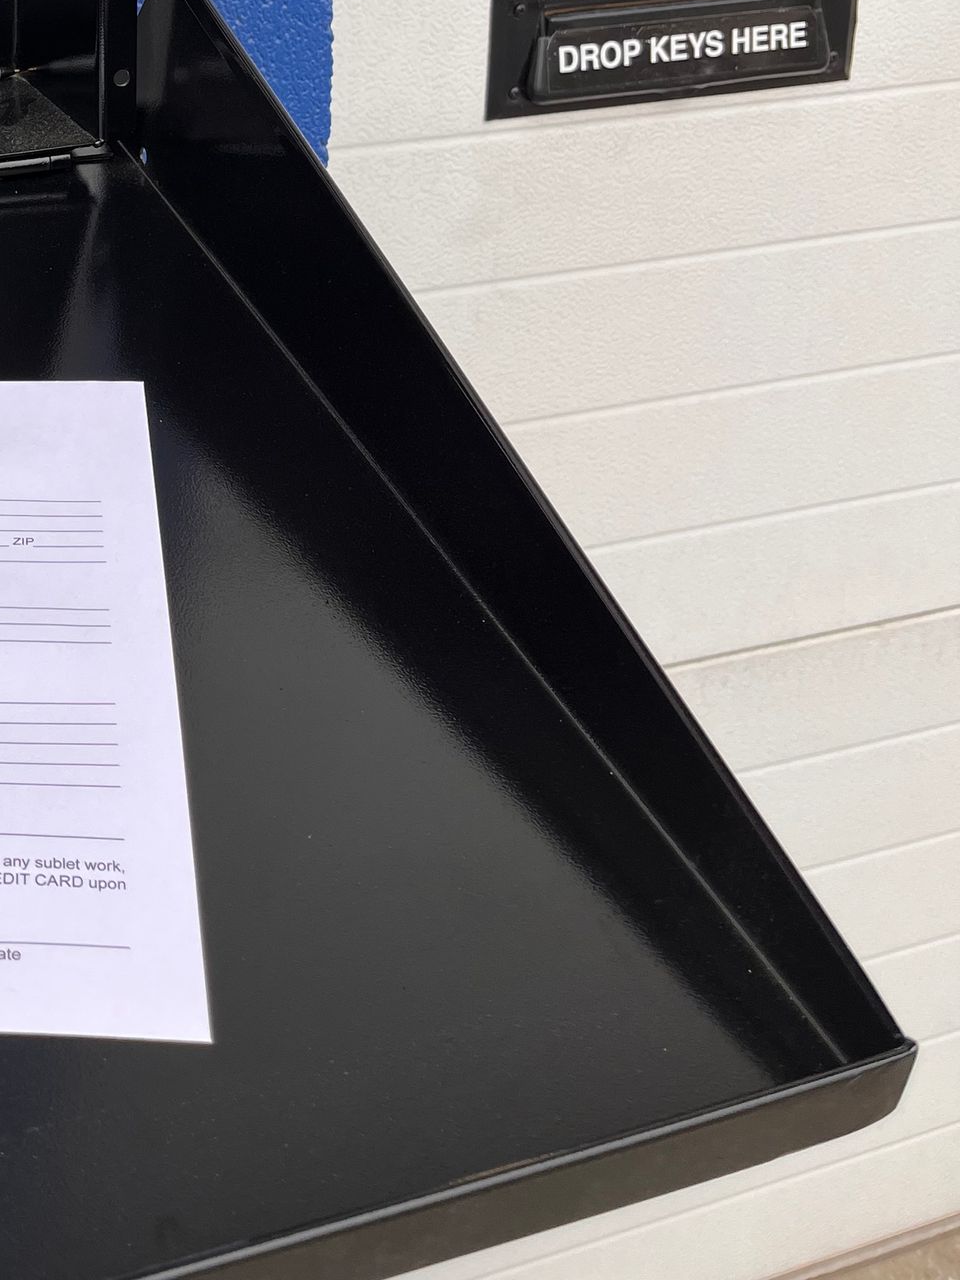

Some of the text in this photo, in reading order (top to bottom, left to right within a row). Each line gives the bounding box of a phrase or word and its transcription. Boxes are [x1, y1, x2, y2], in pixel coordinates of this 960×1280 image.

[558, 21, 807, 74] DROP KEYS HERE
[12, 537, 34, 546] ZIP
[3, 857, 30, 870] any
[35, 858, 80, 870] sublet
[84, 860, 125, 874] work,
[35, 874, 83, 888] CARD
[89, 878, 126, 891] upon
